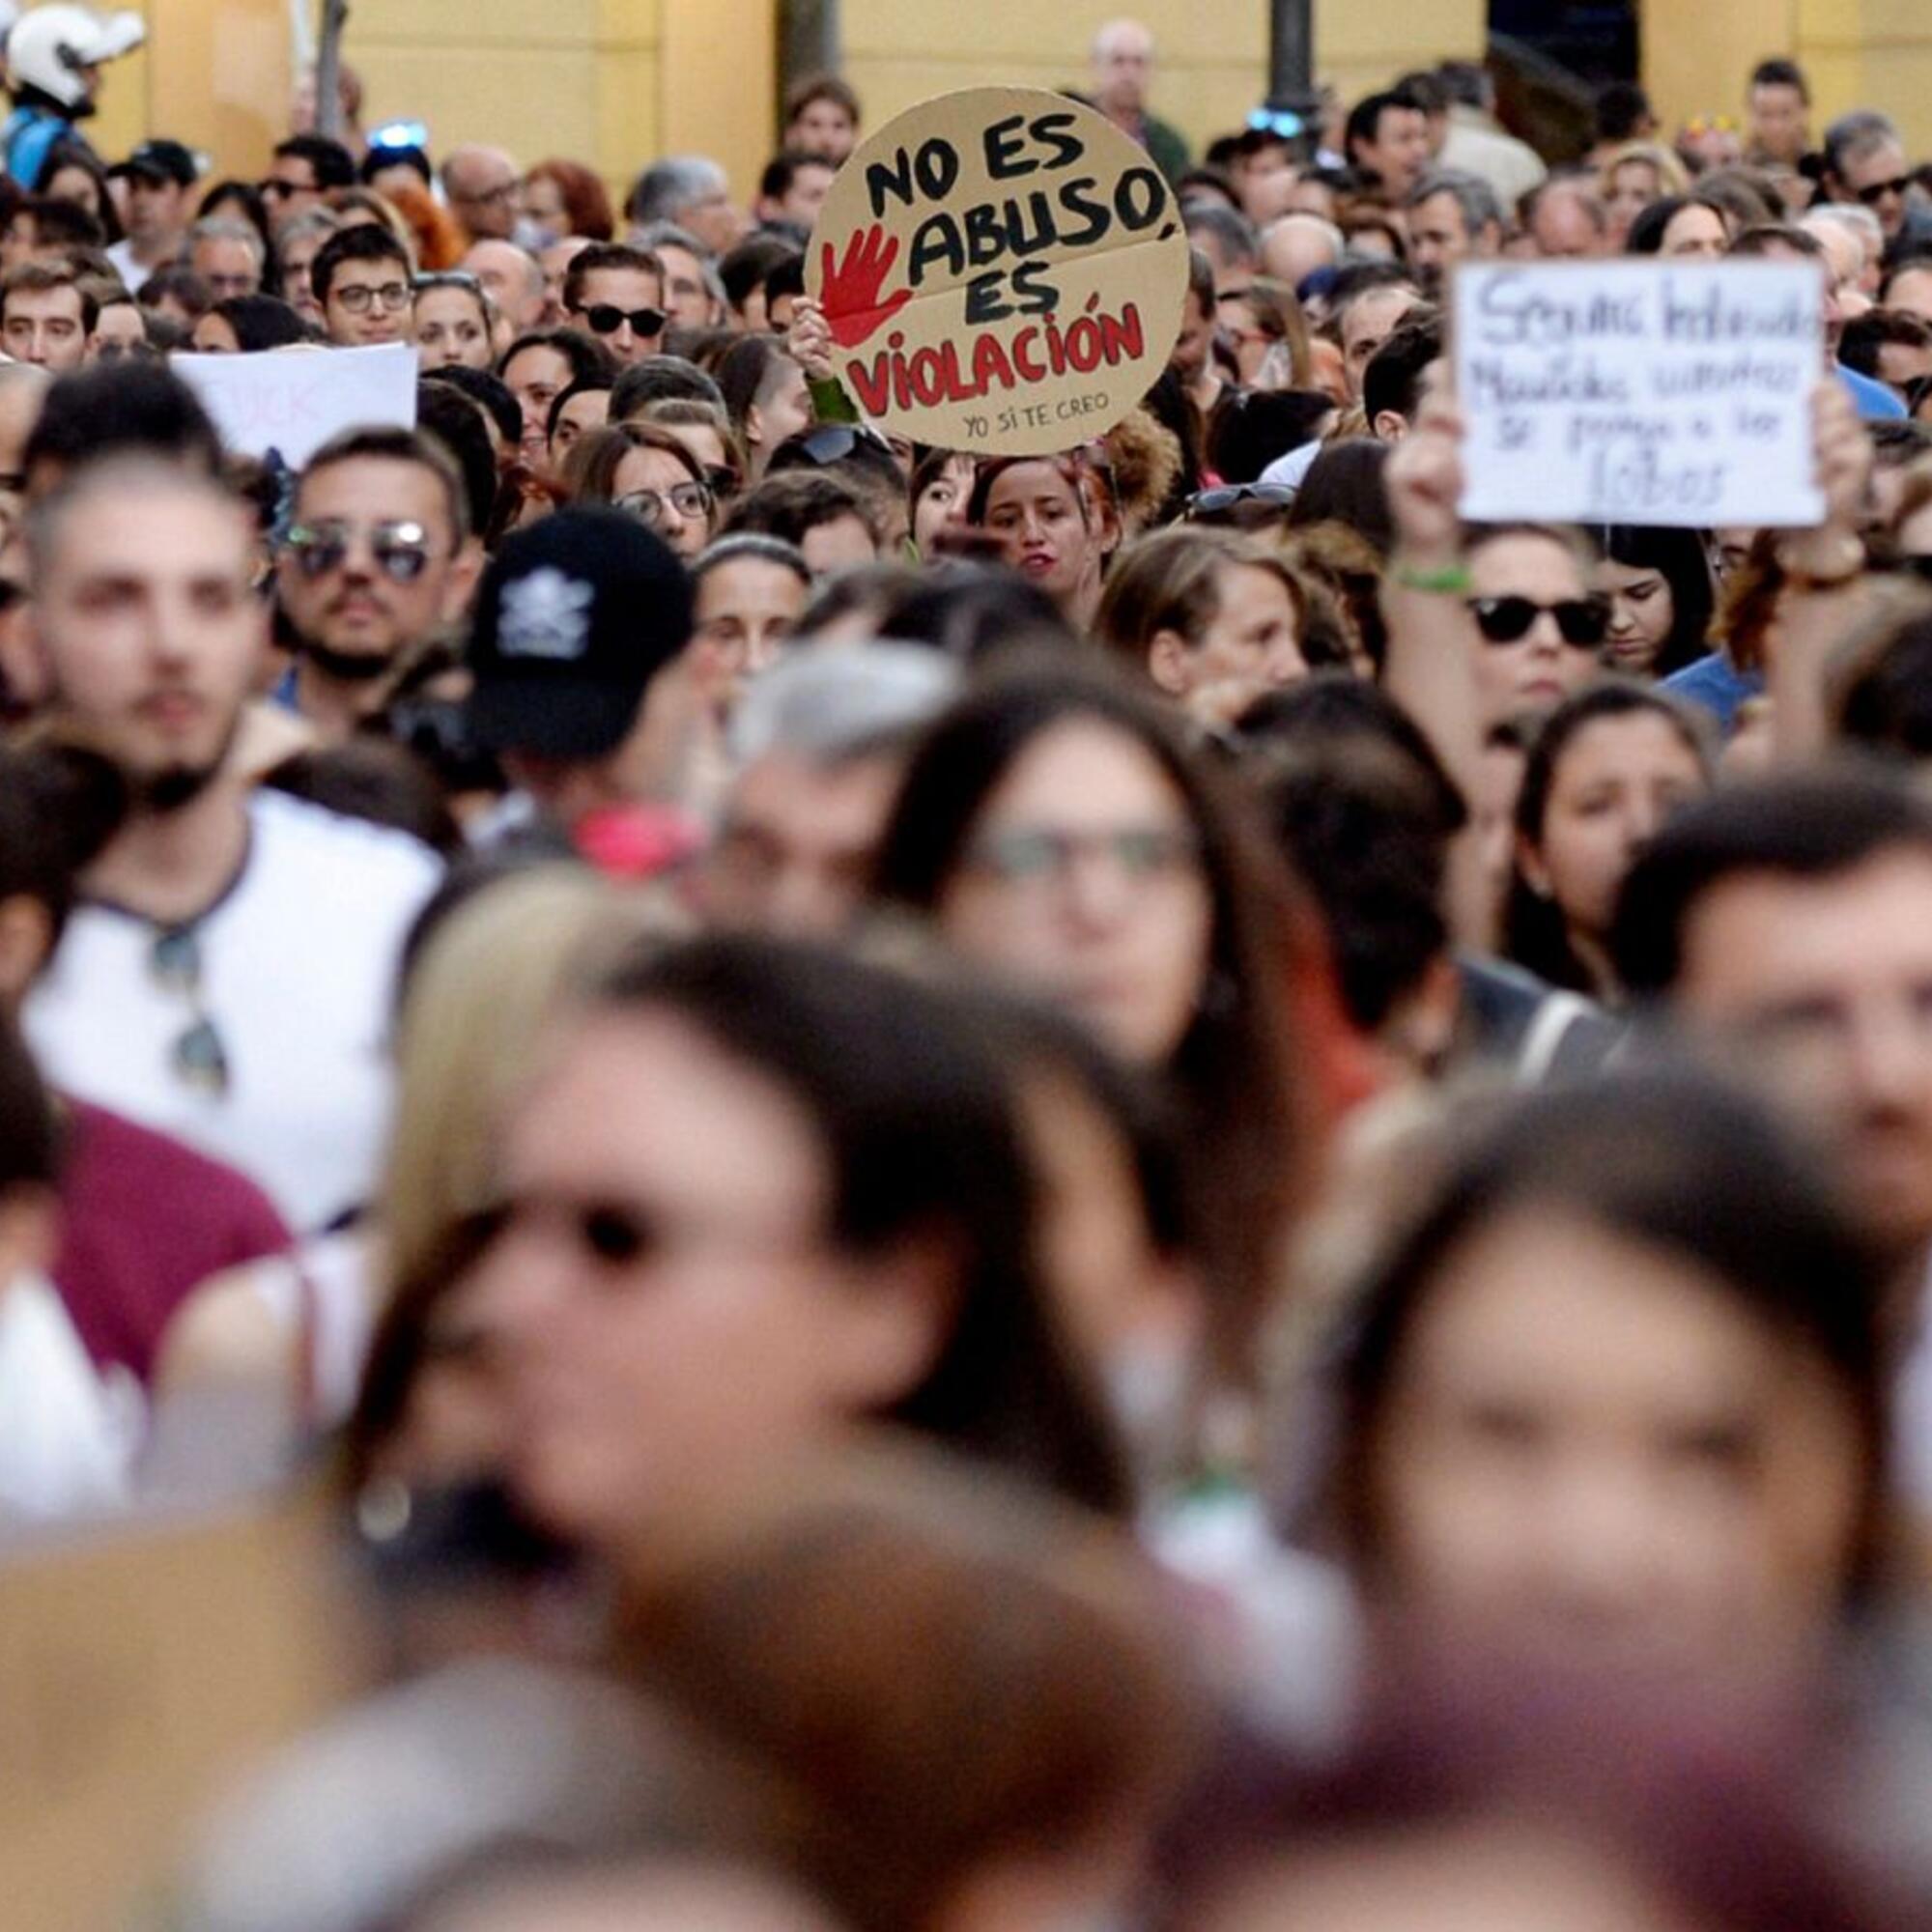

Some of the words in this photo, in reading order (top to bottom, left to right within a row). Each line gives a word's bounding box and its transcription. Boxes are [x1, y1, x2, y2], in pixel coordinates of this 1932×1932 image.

[866, 138, 959, 218] NO
[983, 113, 1085, 181] ES
[908, 167, 1177, 287] ABUSO,
[964, 261, 1060, 327] ES
[962, 414, 988, 438] YO
[1021, 403, 1051, 428] TE
[1056, 392, 1110, 420] CREO
